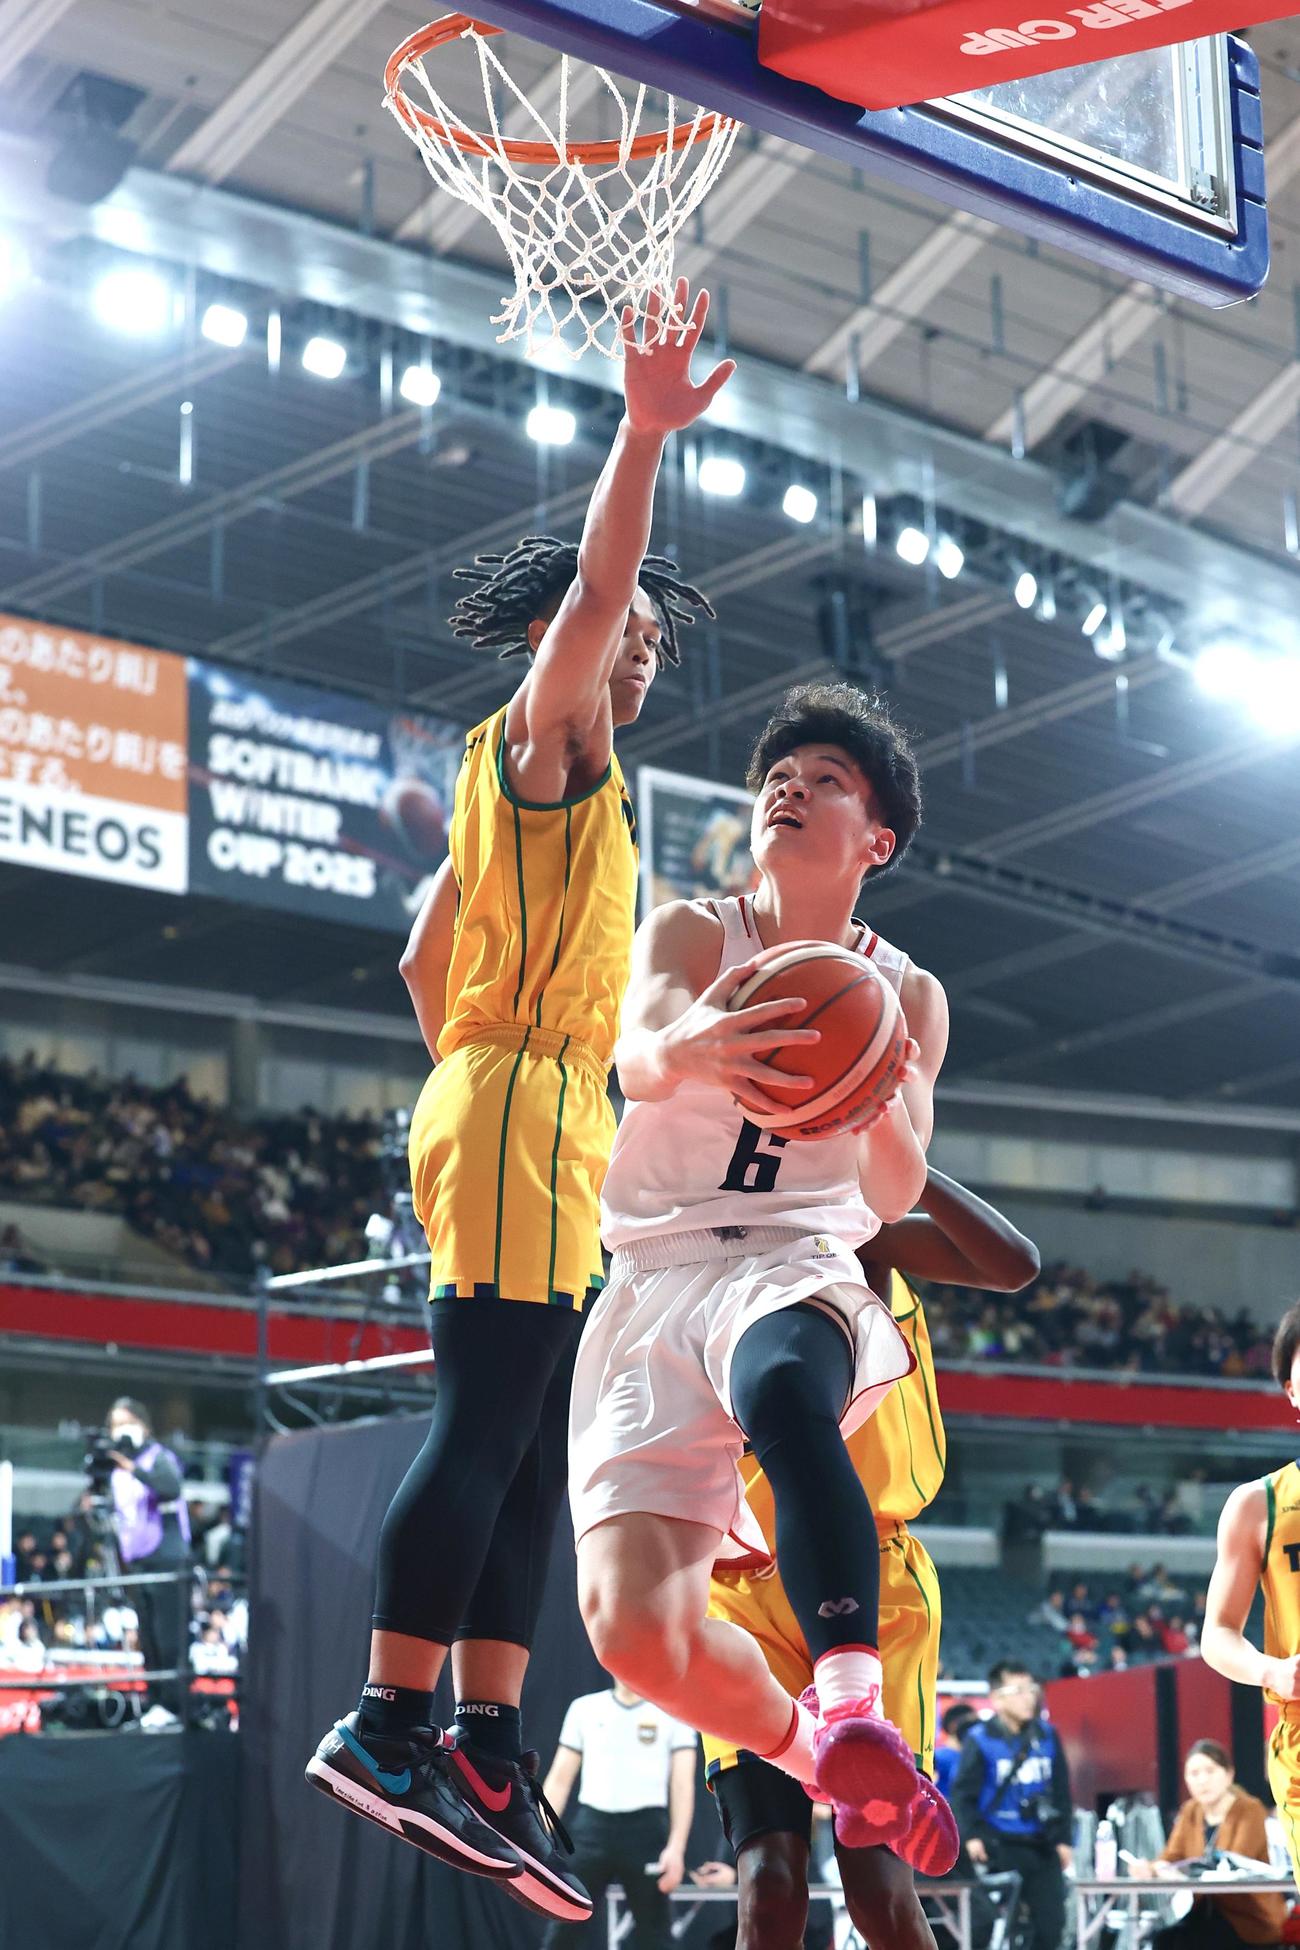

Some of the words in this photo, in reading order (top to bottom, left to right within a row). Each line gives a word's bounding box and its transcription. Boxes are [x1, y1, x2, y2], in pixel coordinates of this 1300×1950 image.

[960, 19, 1077, 55] CUP
[208, 733, 384, 808] SOFTBANK
[209, 779, 342, 844] WINTER
[207, 827, 281, 878] CUP
[283, 842, 377, 898] 2025
[718, 1116, 790, 1193] 6
[362, 1686, 396, 1701] DING
[456, 1704, 499, 1717] DING
